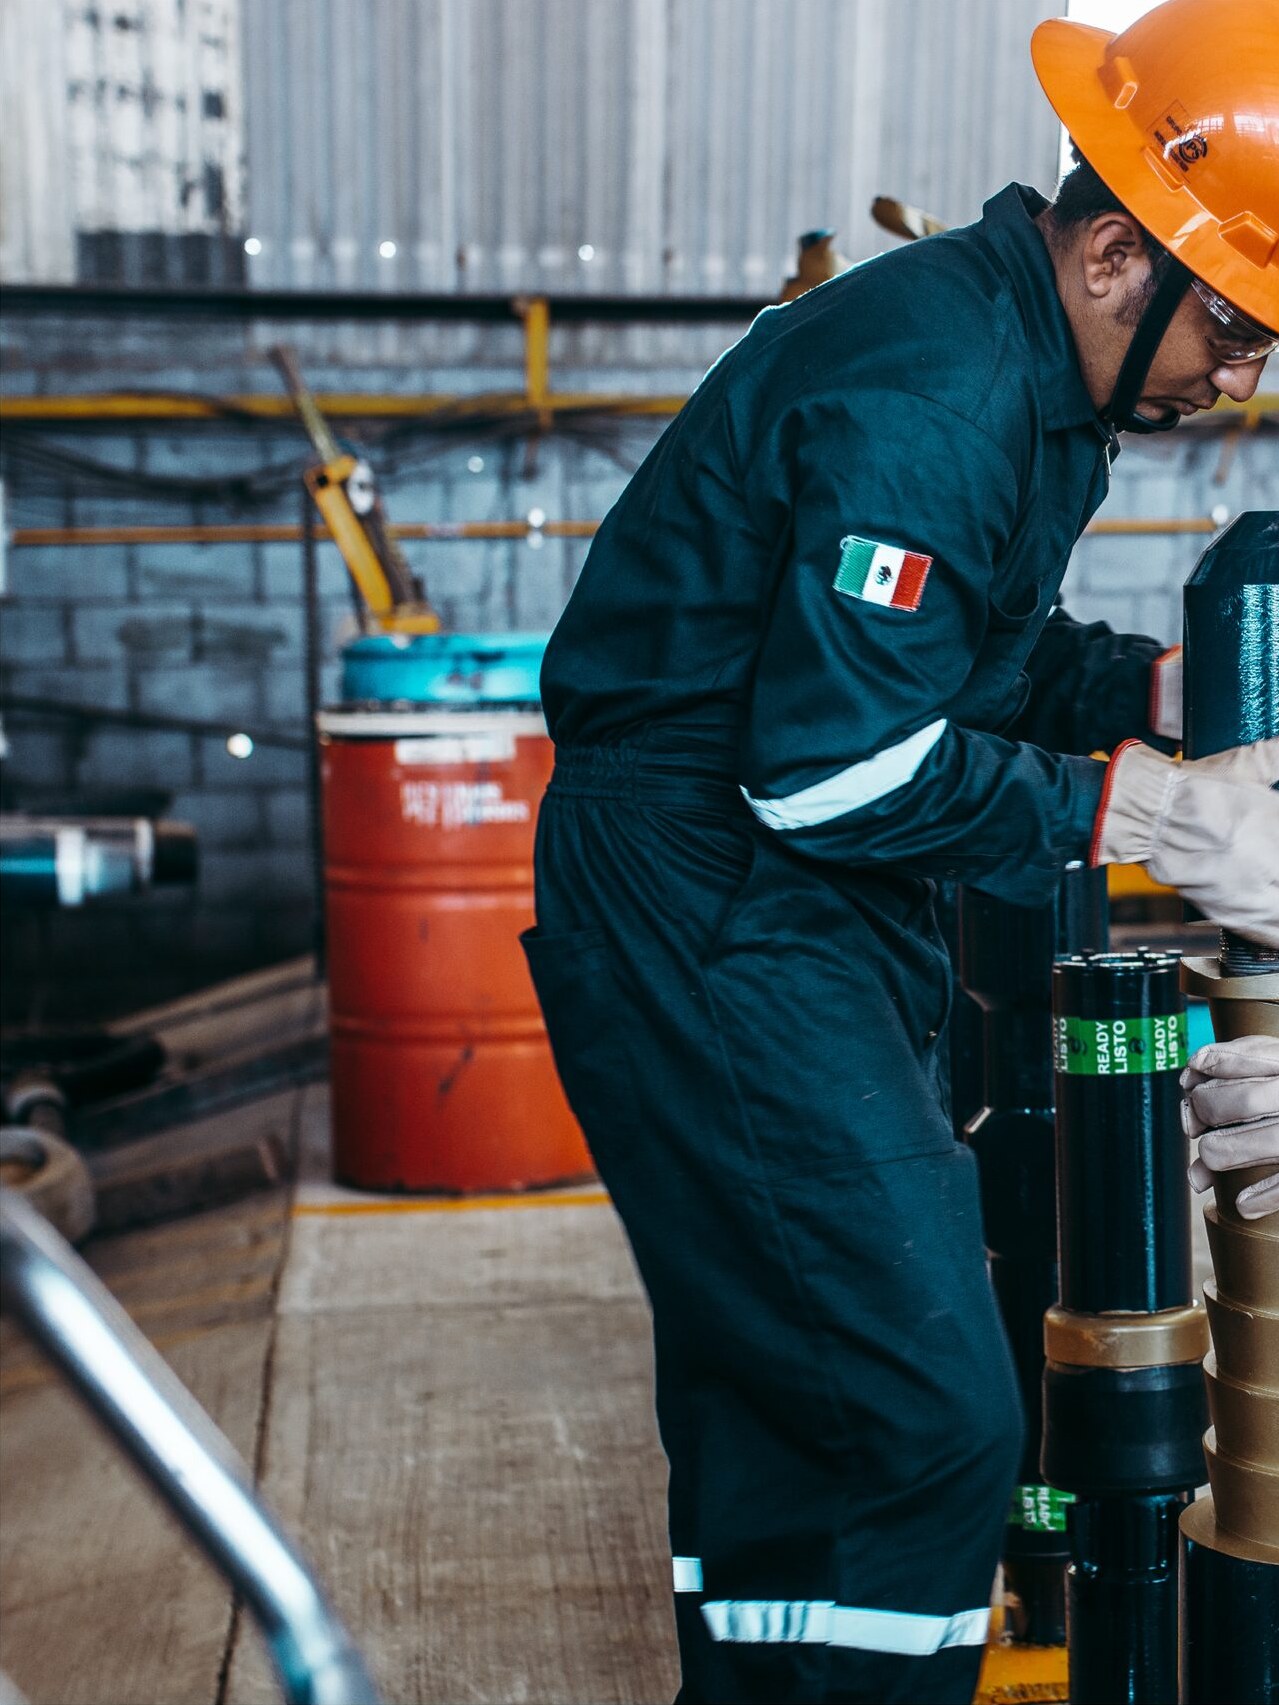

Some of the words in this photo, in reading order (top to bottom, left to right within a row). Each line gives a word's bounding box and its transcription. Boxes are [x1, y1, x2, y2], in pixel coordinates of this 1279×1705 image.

[1060, 1018, 1068, 1070] LISTO
[1095, 1021, 1110, 1074] READY
[1112, 1020, 1128, 1074] LISTO
[1154, 1018, 1167, 1071] READY
[1168, 1015, 1179, 1069] LISTO
